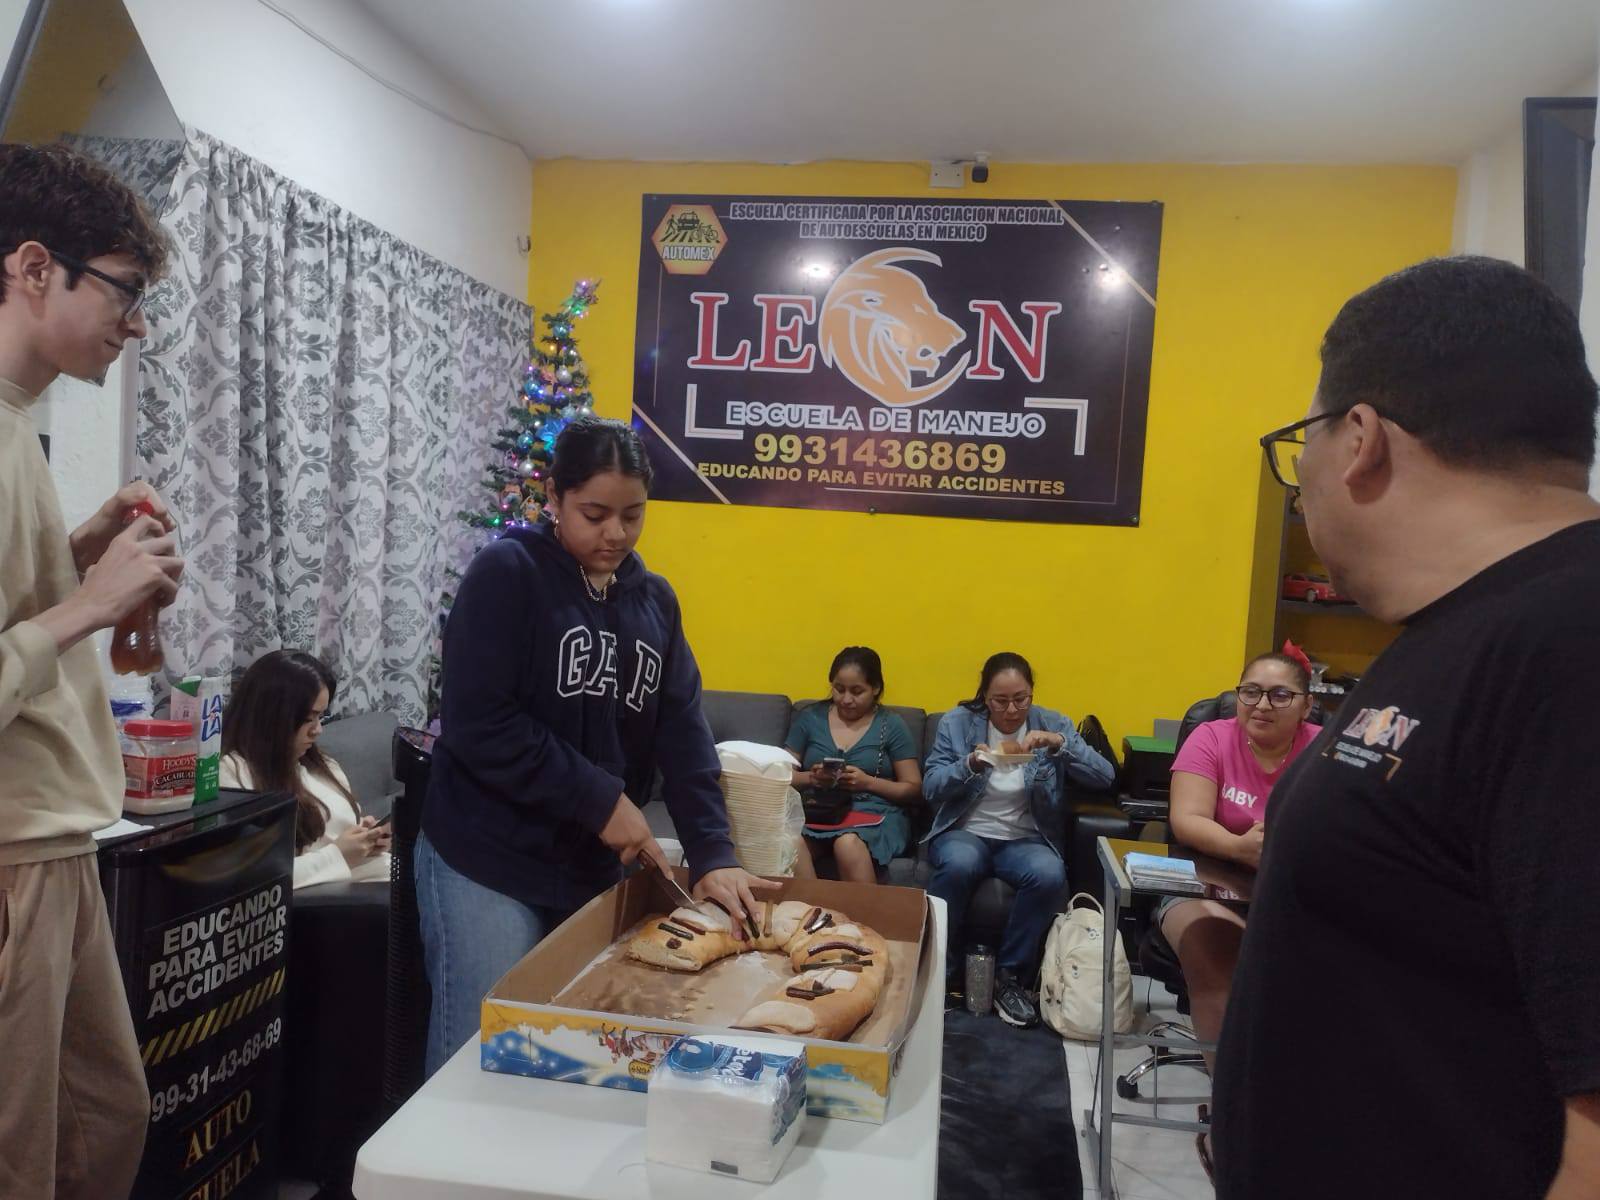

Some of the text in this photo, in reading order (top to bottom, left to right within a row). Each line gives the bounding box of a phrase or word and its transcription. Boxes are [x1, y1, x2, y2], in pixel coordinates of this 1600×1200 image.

[730, 203, 1065, 225] ESCUELA CERTIFICADA POR LA ASOCIACION NACIONAL
[800, 222, 987, 242] DE AUTOESCUELAS EN MEXICO
[662, 245, 715, 261] AUTOMEX
[726, 401, 1047, 439] ESCUELA DE MANEJO
[698, 462, 1065, 496] EDUCANDO PARA EVITAR ACCIDENTES
[754, 432, 1007, 474] 9931436869
[557, 624, 662, 713] GAP
[149, 905, 287, 991] PARA EVITAR
[163, 884, 282, 956] EDUCANDO
[147, 930, 285, 1020] ACCIDENTES
[151, 1017, 282, 1122] 99-31-43-68-69
[184, 1089, 252, 1168] AUTO
